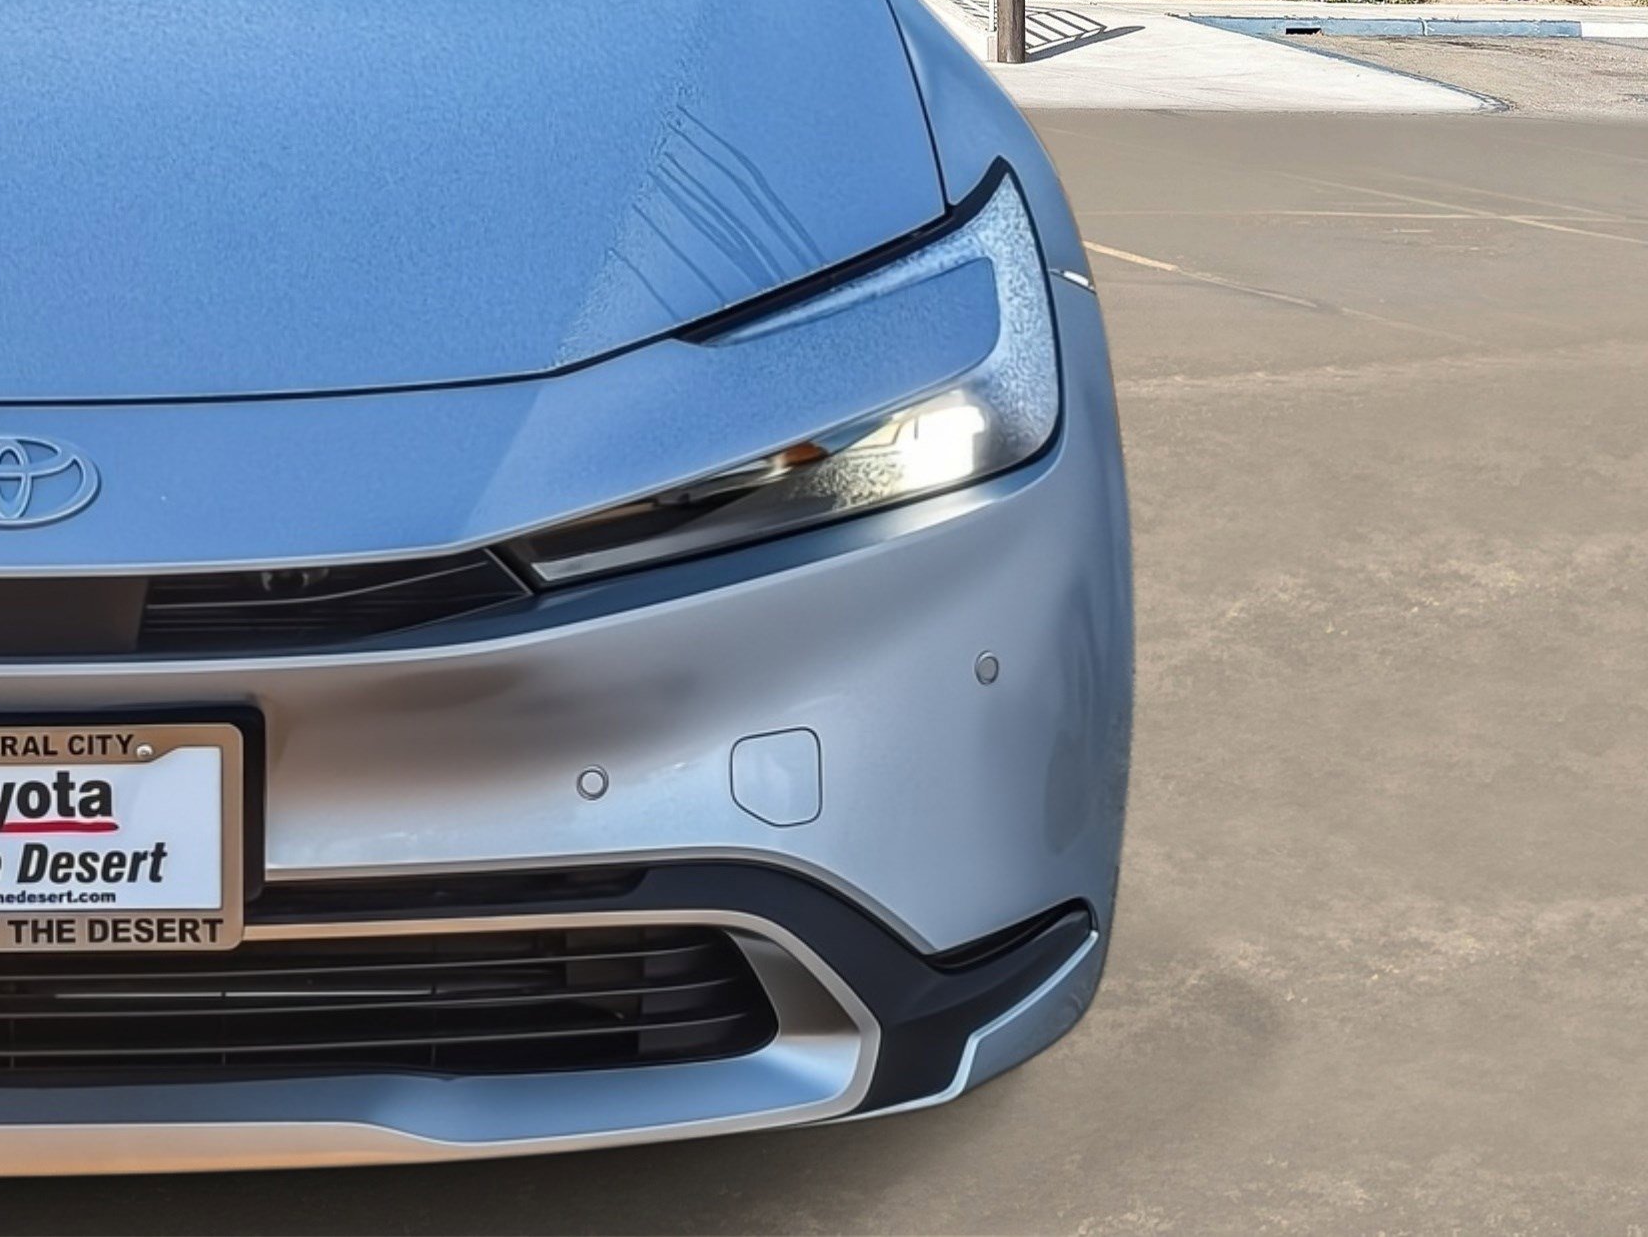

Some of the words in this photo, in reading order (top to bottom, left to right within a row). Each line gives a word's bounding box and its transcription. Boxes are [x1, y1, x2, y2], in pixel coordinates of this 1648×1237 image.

[67, 734, 134, 756] CITY
[16, 842, 168, 884] Desert
[7, 919, 77, 944] THE
[87, 917, 224, 944] DESERT
